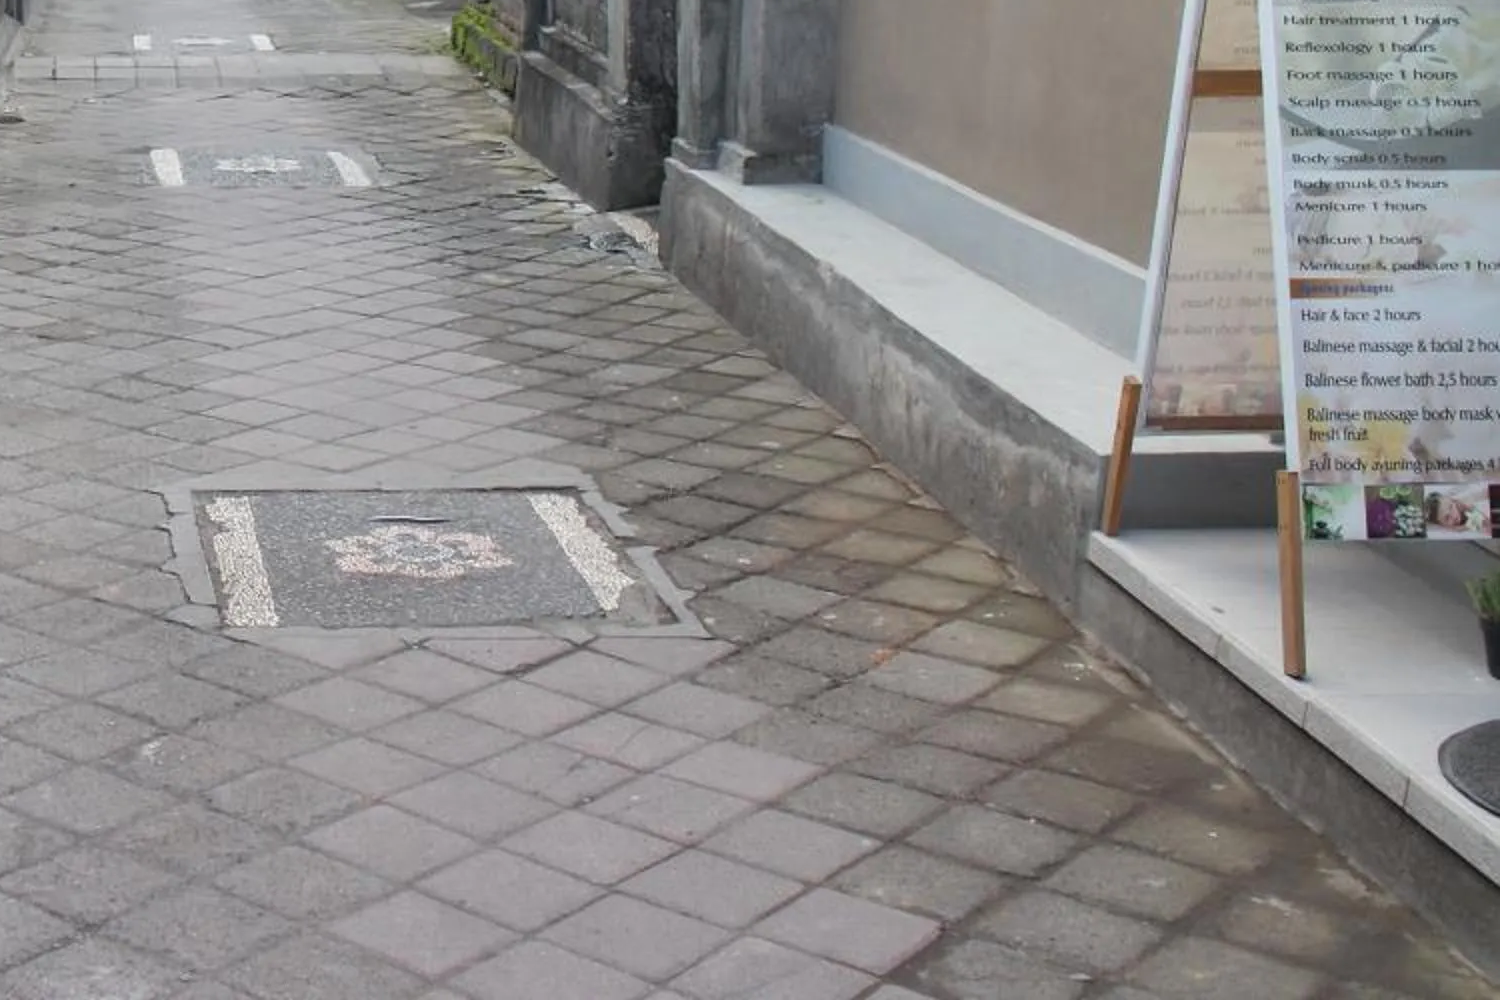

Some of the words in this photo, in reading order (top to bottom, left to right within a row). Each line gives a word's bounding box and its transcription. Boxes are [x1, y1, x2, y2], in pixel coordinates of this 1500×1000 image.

[1283, 15, 1315, 25] Hair
[1319, 16, 1396, 25] treatment
[1415, 15, 1460, 25] hours
[1285, 42, 1372, 54] Reflexology
[1392, 43, 1436, 53] hours
[1286, 70, 1323, 81] Foot
[1327, 71, 1394, 83] massage
[1413, 69, 1459, 81] hours
[1289, 96, 1330, 109] Scalp
[1335, 98, 1402, 111] massage
[1436, 96, 1481, 107] hours
[1427, 126, 1473, 137] hours
[1292, 153, 1331, 164] Body
[1404, 153, 1448, 164] hours
[1293, 179, 1331, 190] Body
[1405, 179, 1449, 189] hours
[1385, 202, 1428, 212] hours
[1379, 234, 1423, 245] hours
[1477, 260, 1500, 271] ho
[1301, 309, 1327, 321] Hair
[1330, 309, 1340, 321] &
[1373, 309, 1381, 321] 2
[1385, 309, 1422, 321] hours
[1303, 339, 1356, 353] Balinese
[1359, 341, 1414, 356] massage
[1417, 340, 1426, 352] &
[1466, 340, 1474, 352] 2
[1305, 373, 1357, 387] Balinese
[1361, 372, 1401, 387] flower
[1404, 372, 1434, 387] bath
[1460, 371, 1498, 387] hours
[1307, 408, 1360, 422] Balinese
[1363, 409, 1419, 423] massage
[1422, 407, 1457, 423] body
[1459, 407, 1494, 422] mask
[1309, 427, 1340, 442] fresh
[1335, 456, 1369, 473] body
[1371, 457, 1422, 473] ayuning
[1425, 456, 1484, 475] packages
